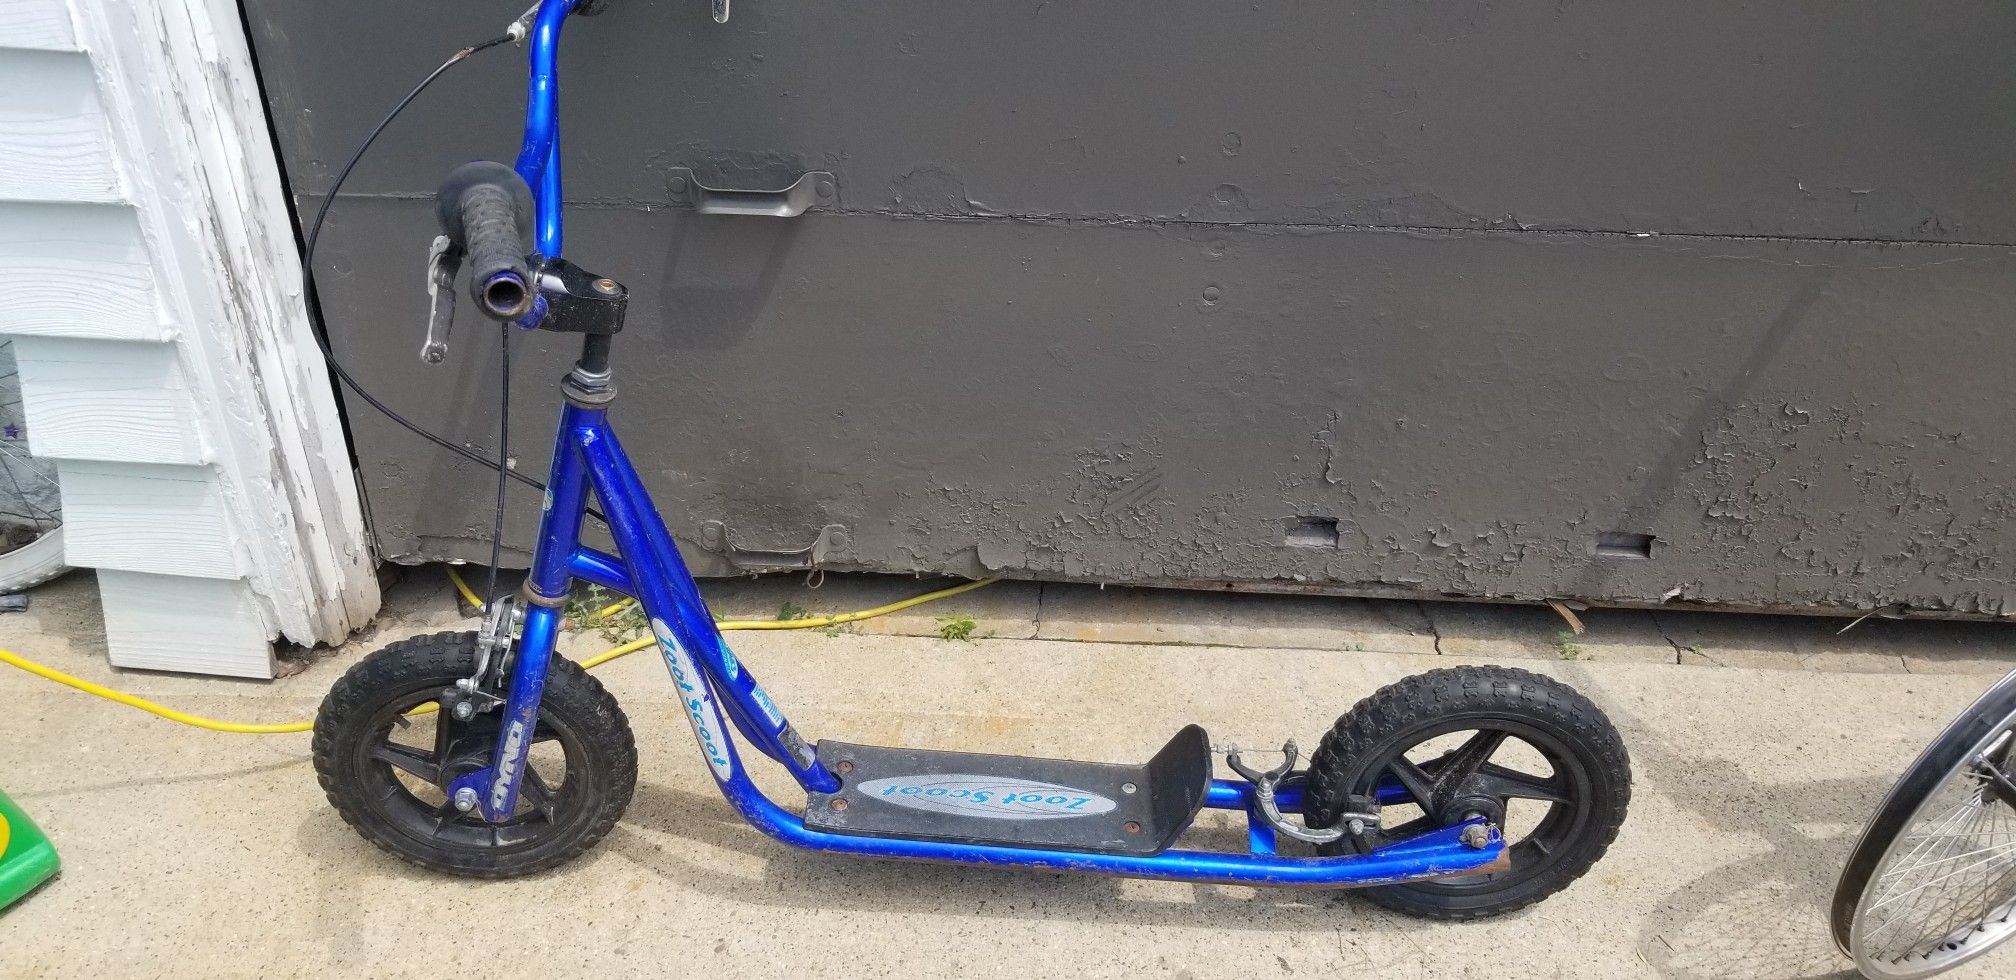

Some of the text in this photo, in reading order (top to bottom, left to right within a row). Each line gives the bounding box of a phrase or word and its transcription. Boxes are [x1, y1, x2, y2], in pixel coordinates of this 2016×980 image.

[658, 635, 693, 693] Zoot
[685, 696, 728, 767] Scoot
[491, 720, 523, 810] DYNO
[881, 785, 1092, 810] Zoot Scoot
